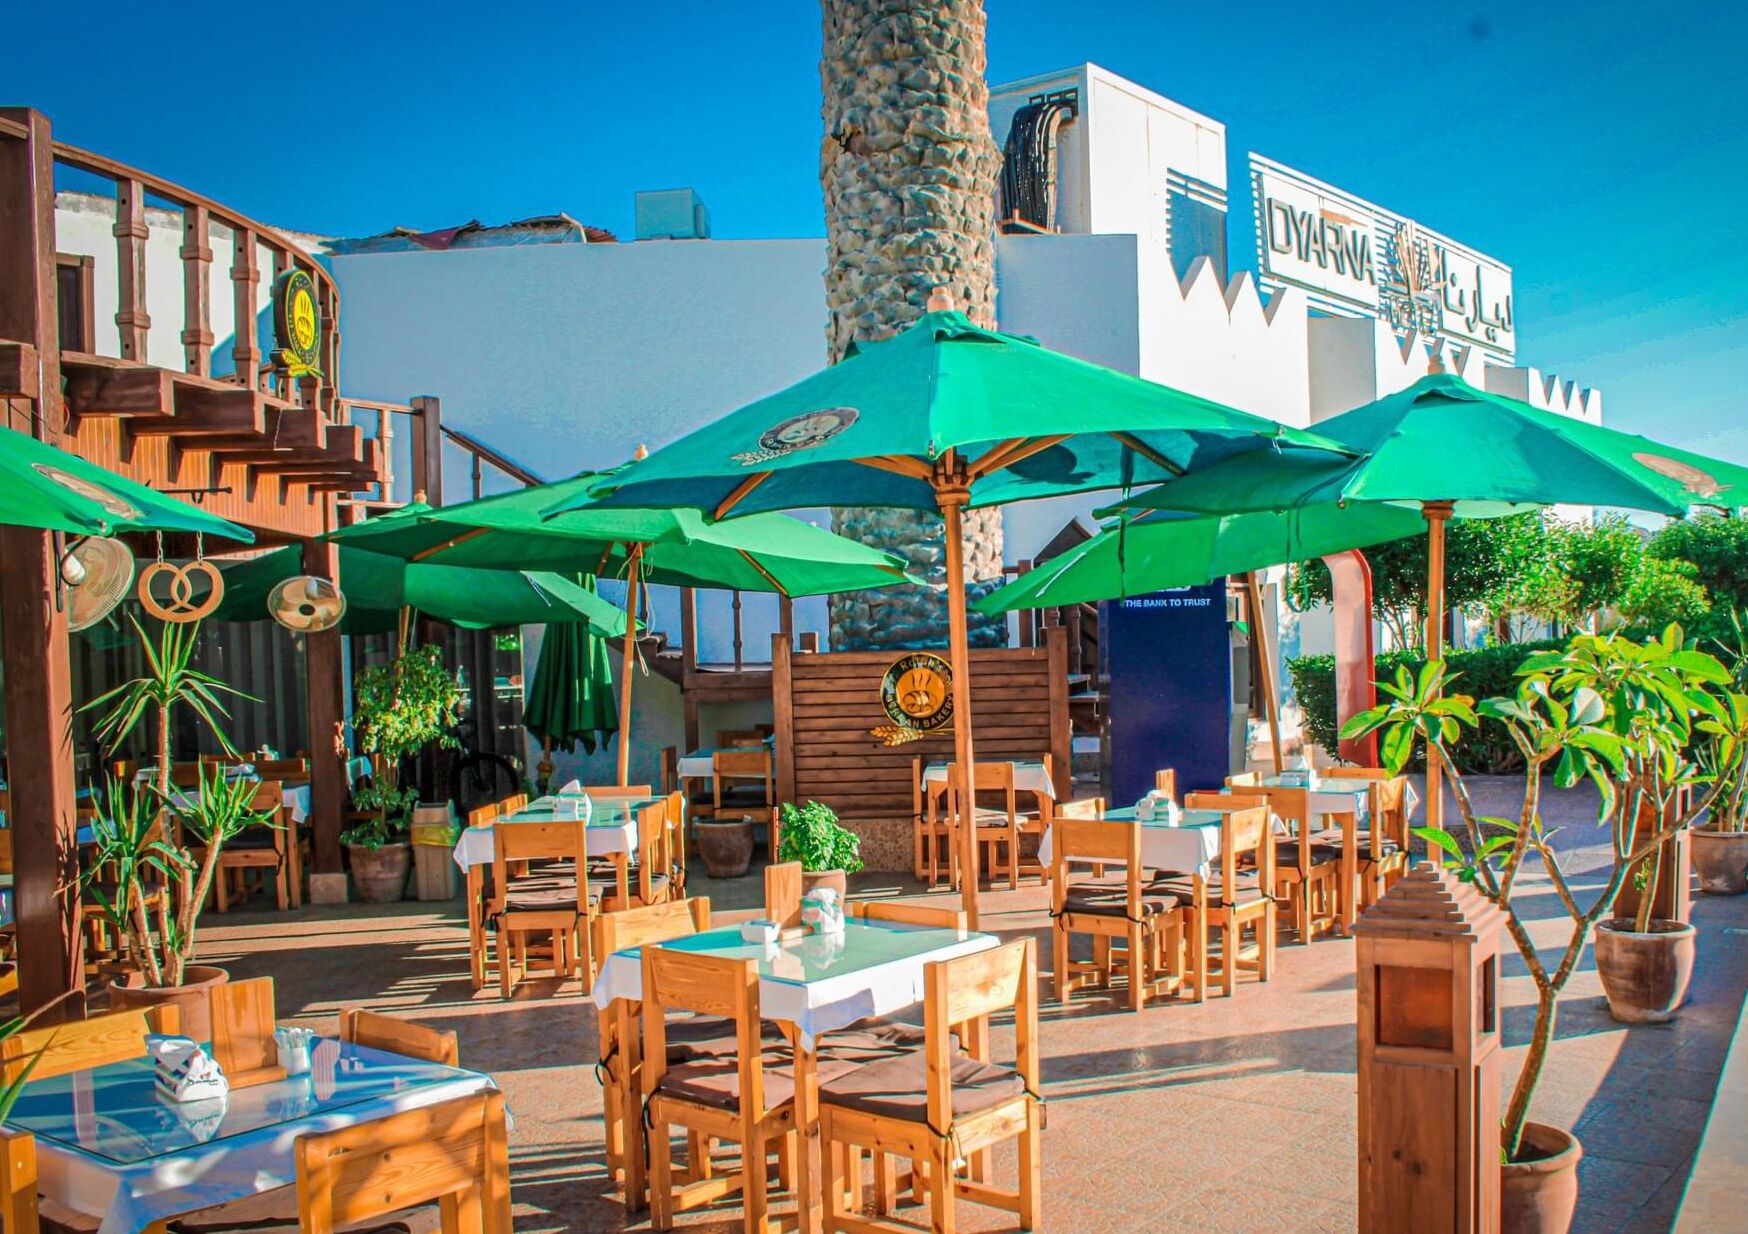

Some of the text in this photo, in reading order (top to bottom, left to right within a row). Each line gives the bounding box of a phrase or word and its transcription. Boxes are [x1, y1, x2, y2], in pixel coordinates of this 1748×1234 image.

[1267, 197, 1376, 285] DYARNA
[1125, 598, 1211, 608] THE BANK TO TRUST
[923, 692, 953, 728] BAKERY
